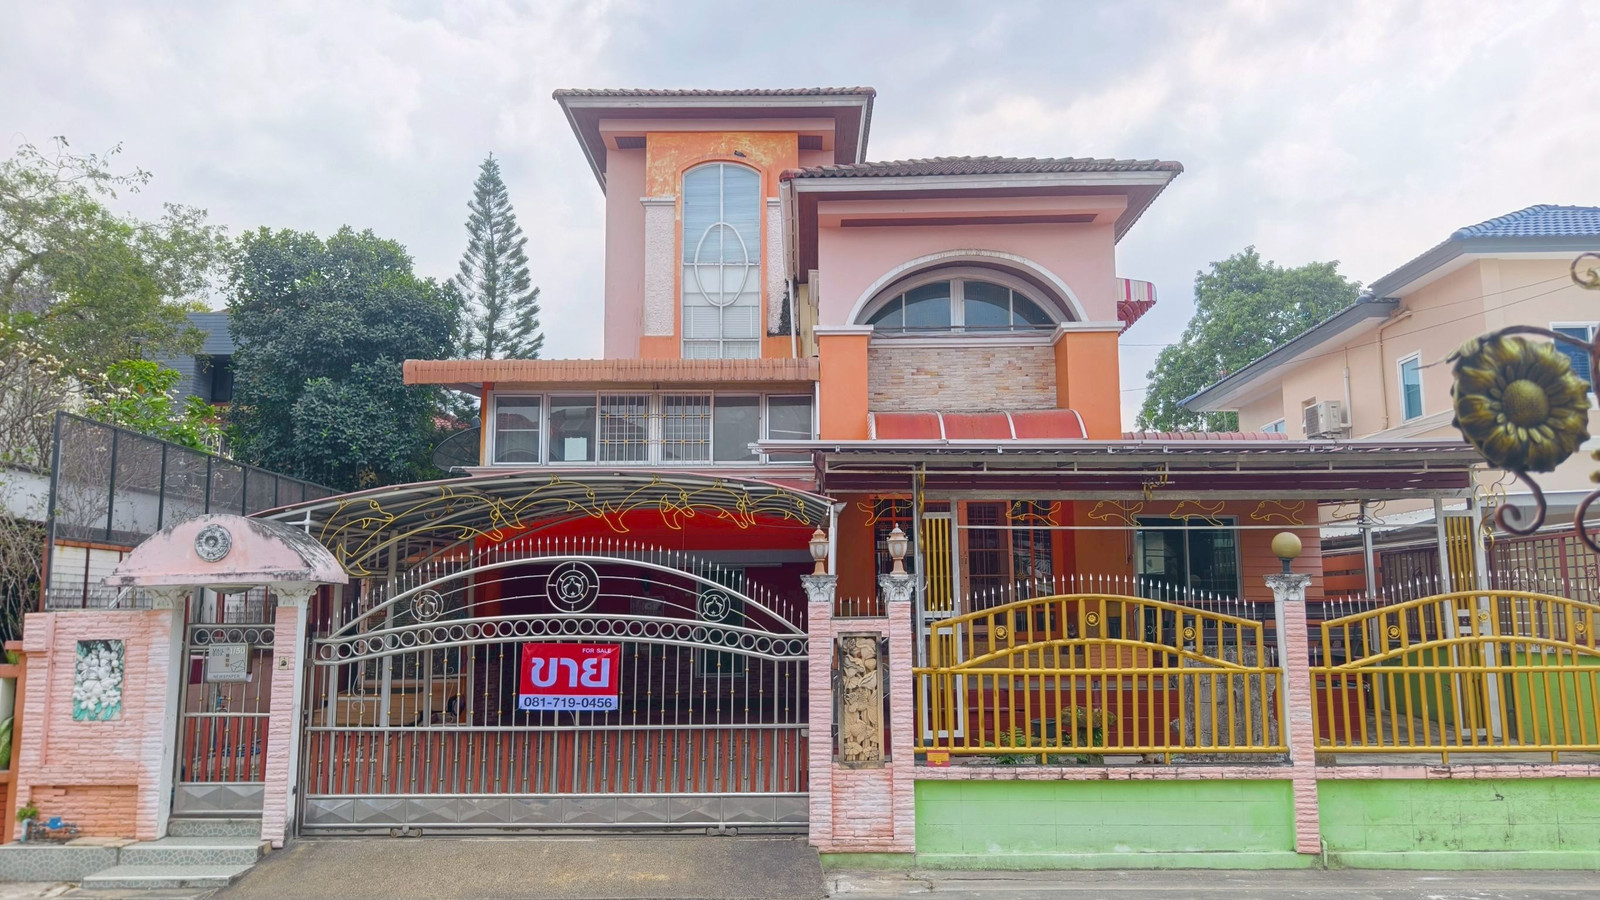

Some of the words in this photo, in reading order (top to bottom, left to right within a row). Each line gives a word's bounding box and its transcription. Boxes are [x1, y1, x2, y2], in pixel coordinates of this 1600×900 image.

[230, 647, 245, 655] 1/50
[531, 657, 610, 687] ขาย
[524, 697, 612, 708] 081-719-0456
